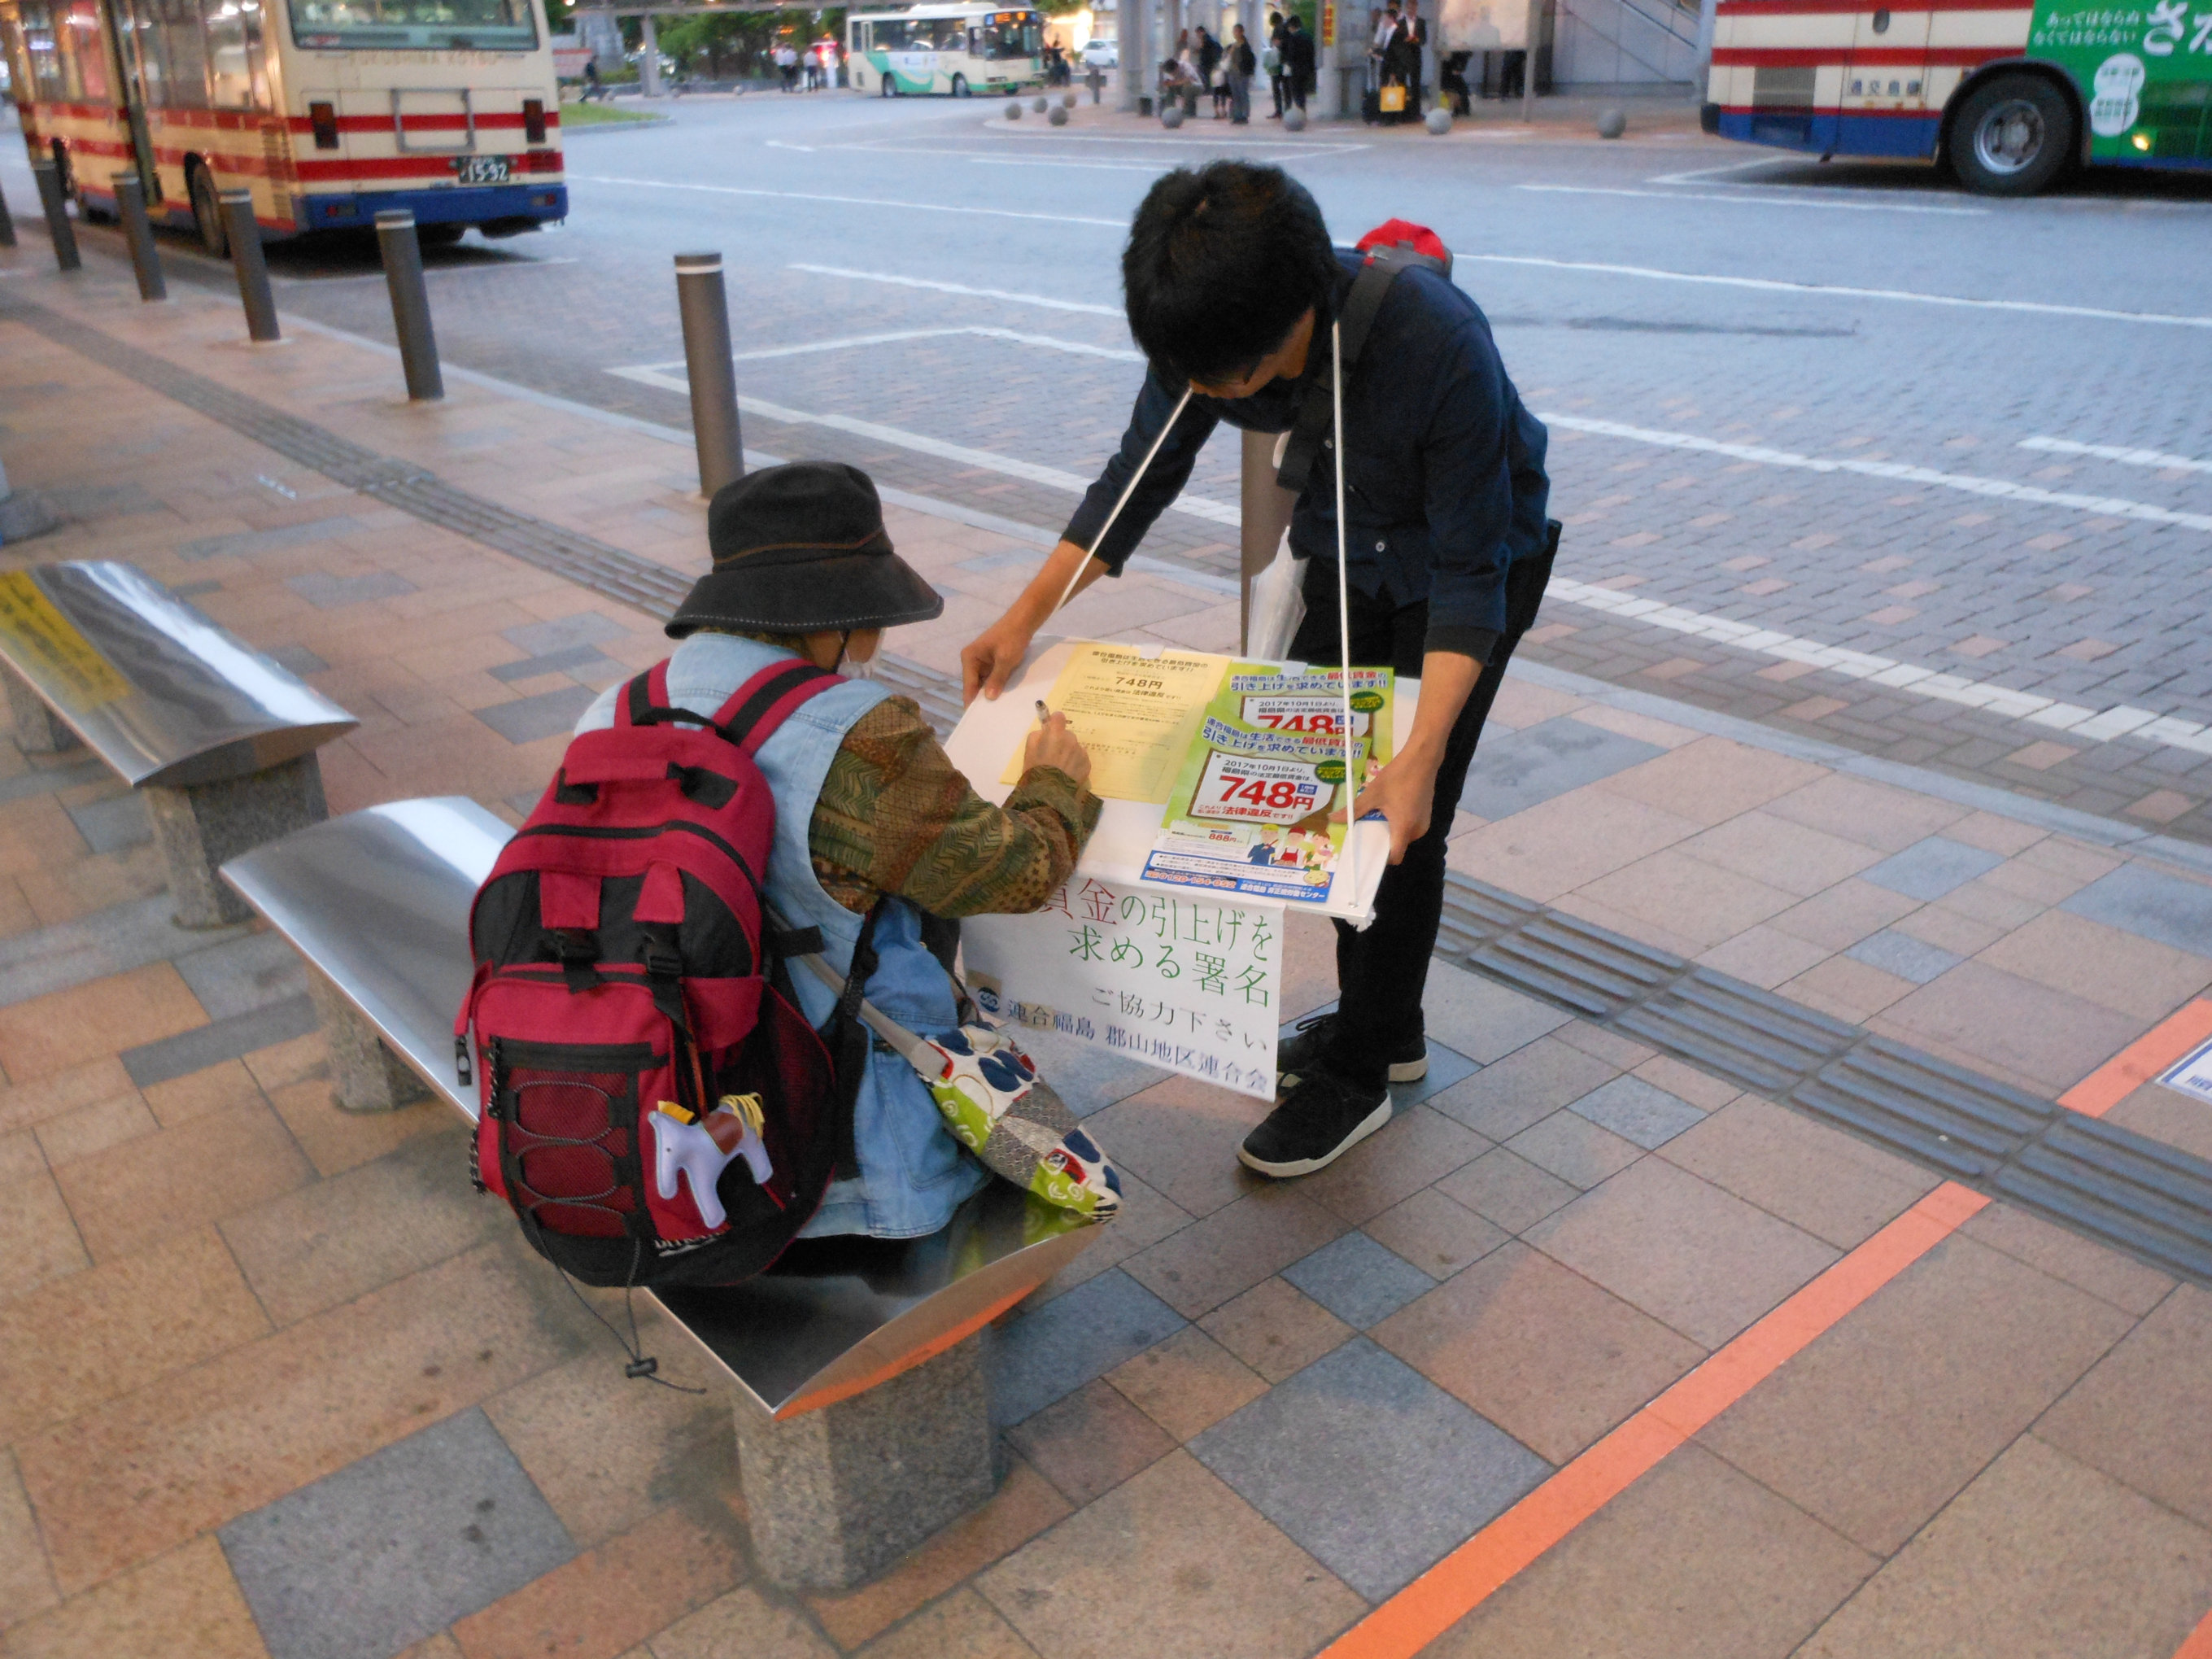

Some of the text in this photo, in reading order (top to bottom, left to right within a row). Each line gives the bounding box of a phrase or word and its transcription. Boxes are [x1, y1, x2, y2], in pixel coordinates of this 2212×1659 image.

[1115, 676, 1163, 690] 748円
[1219, 775, 1315, 811] 748円
[1208, 832, 1237, 843] 888円
[1067, 924, 1269, 1009] 求める署名
[1091, 986, 1267, 1051] ご協力下さい
[1008, 998, 1267, 1094] 連合福島 郡山地区連合会
